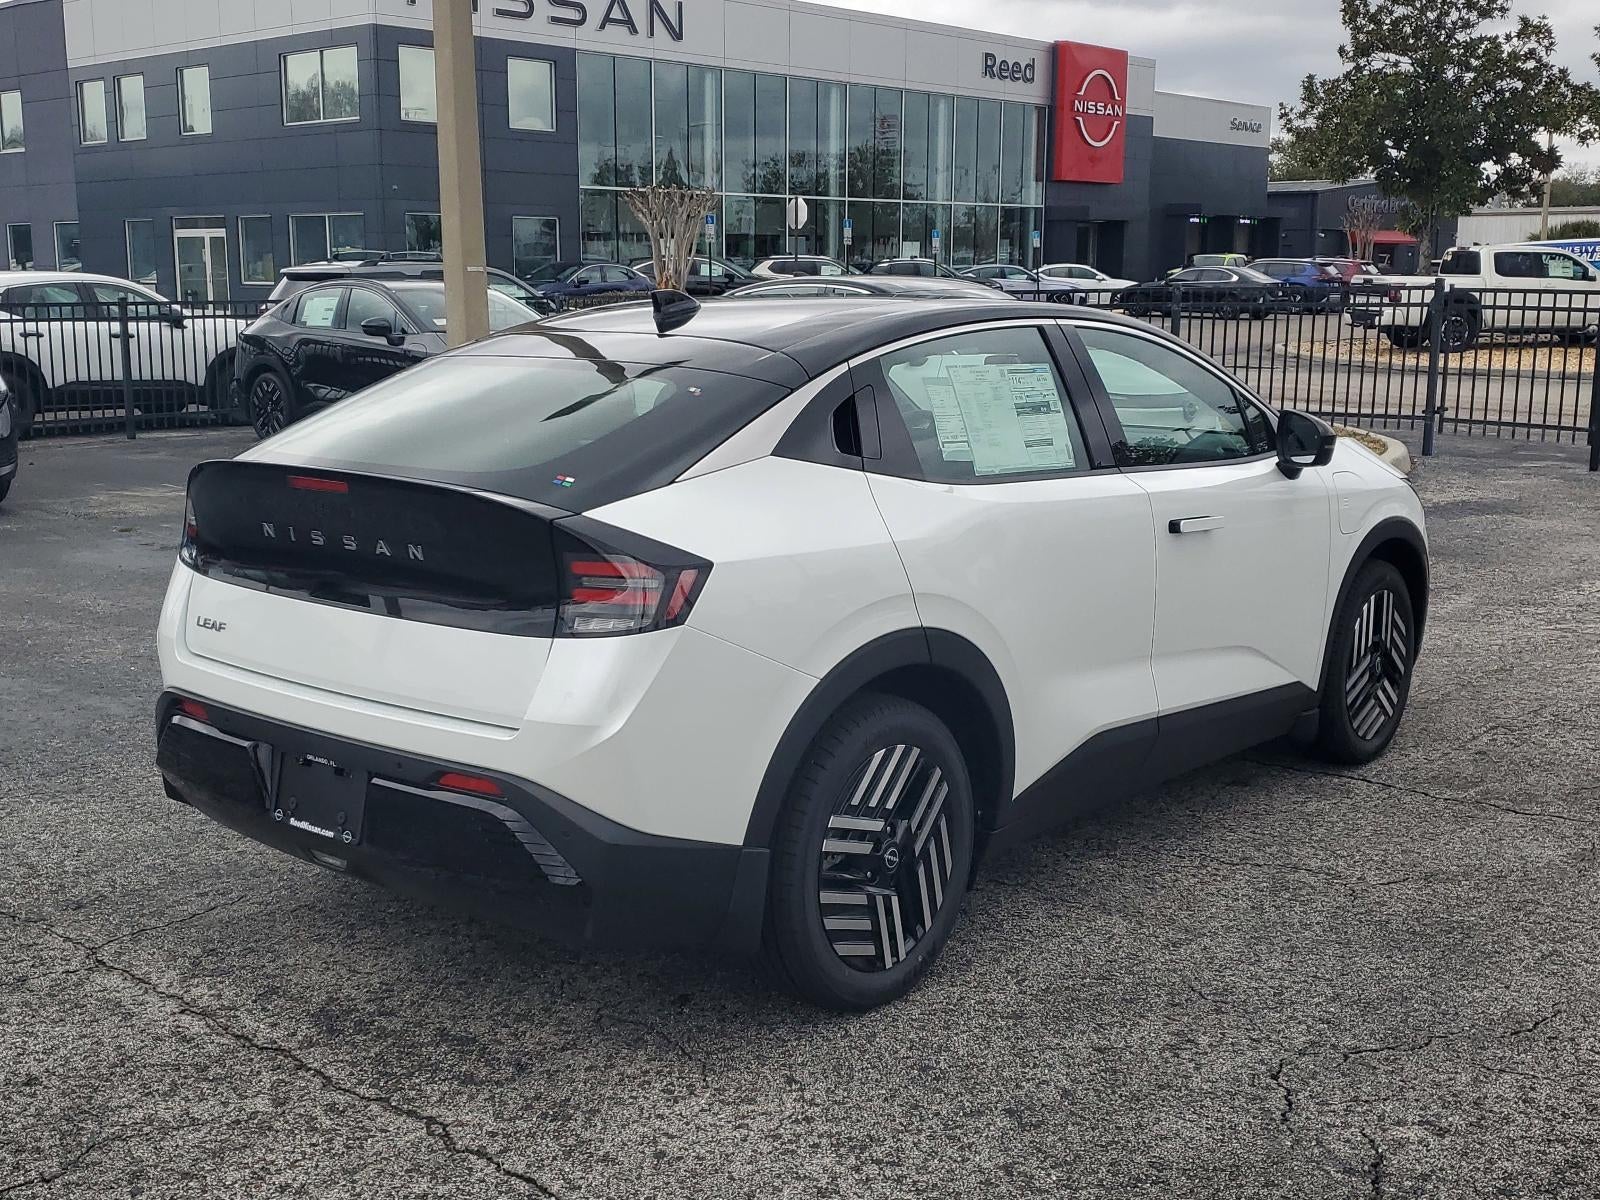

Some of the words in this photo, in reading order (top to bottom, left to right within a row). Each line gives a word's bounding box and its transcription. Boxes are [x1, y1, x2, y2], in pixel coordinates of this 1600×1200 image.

[982, 52, 1036, 84] Reed
[1073, 98, 1123, 118] NISSAN
[1230, 117, 1263, 134] Service
[261, 521, 425, 562] NISSAN
[196, 615, 227, 633] LEAF
[289, 817, 334, 838] ReedNissan.com
